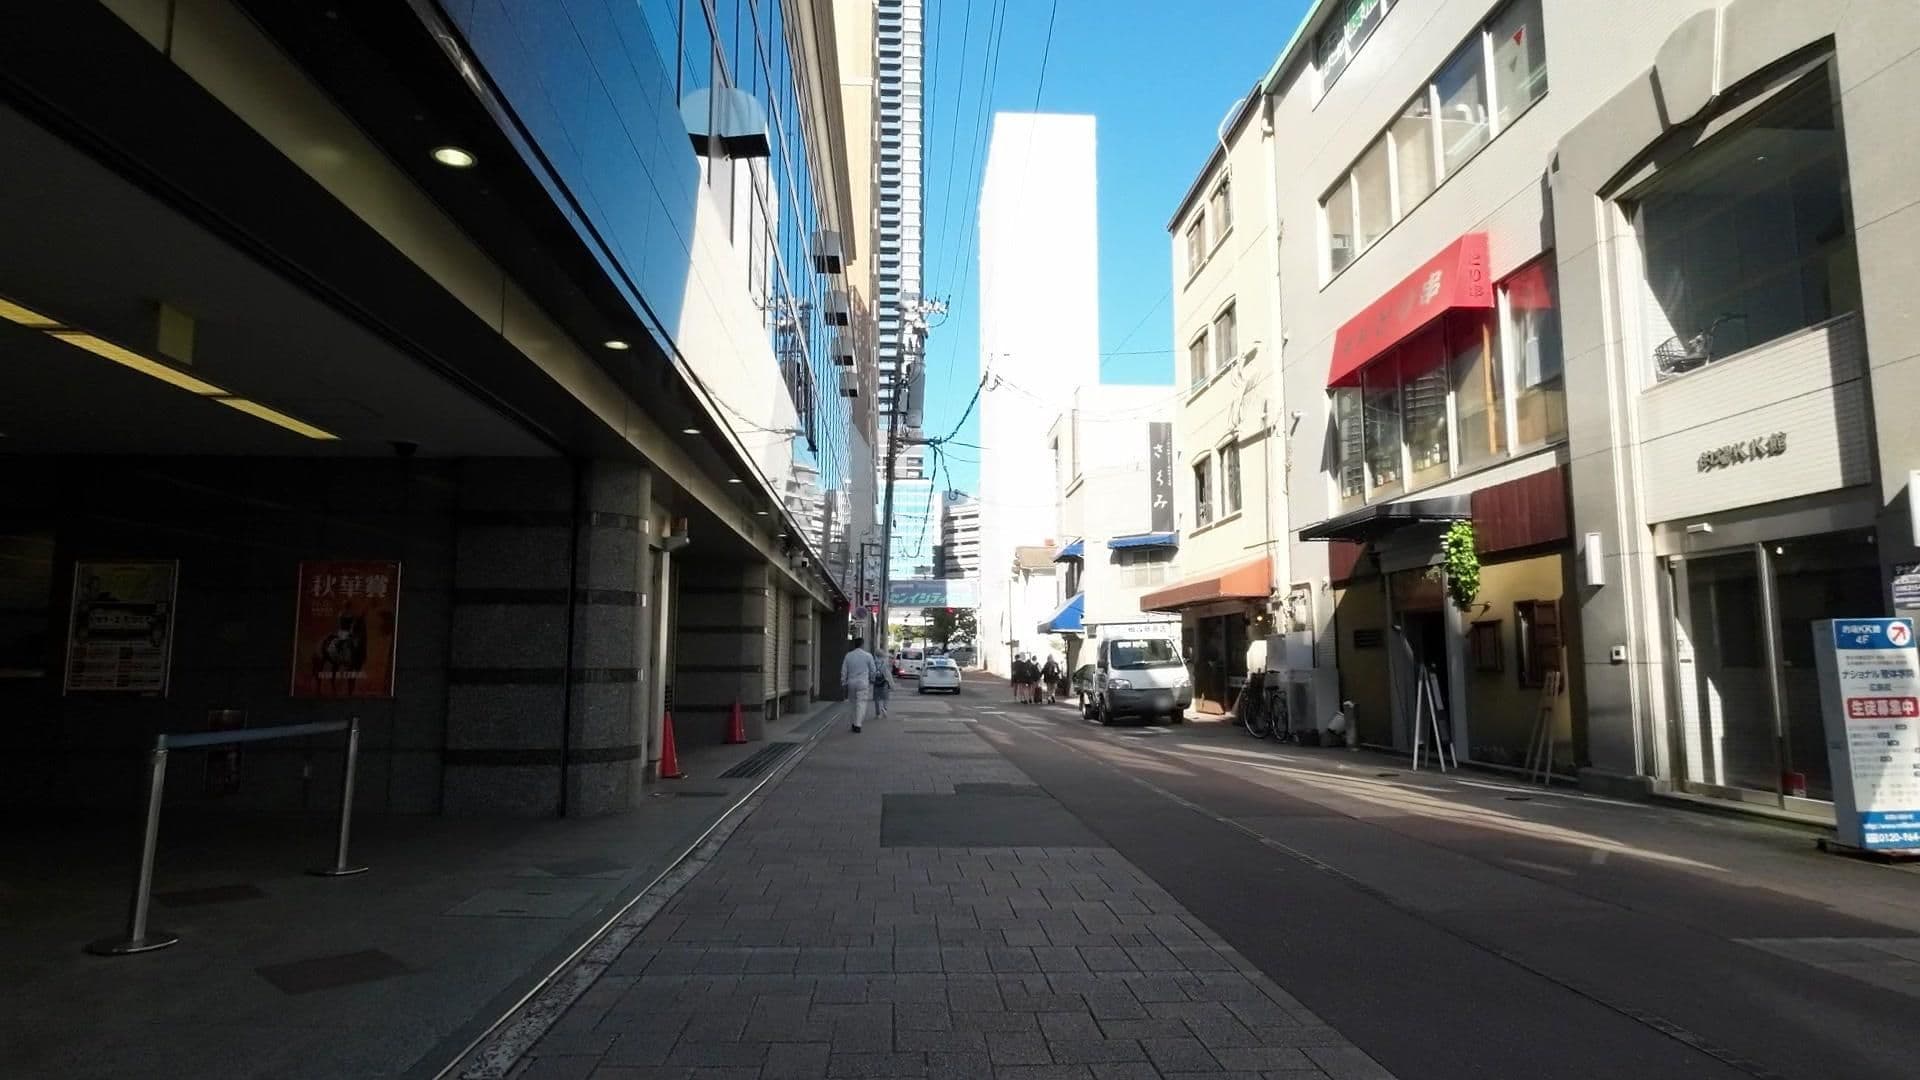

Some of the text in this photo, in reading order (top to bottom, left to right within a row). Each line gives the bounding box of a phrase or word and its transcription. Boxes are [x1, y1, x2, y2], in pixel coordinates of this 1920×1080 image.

[311, 573, 388, 599] 秋華賞
[1856, 635, 1870, 644] 4F
